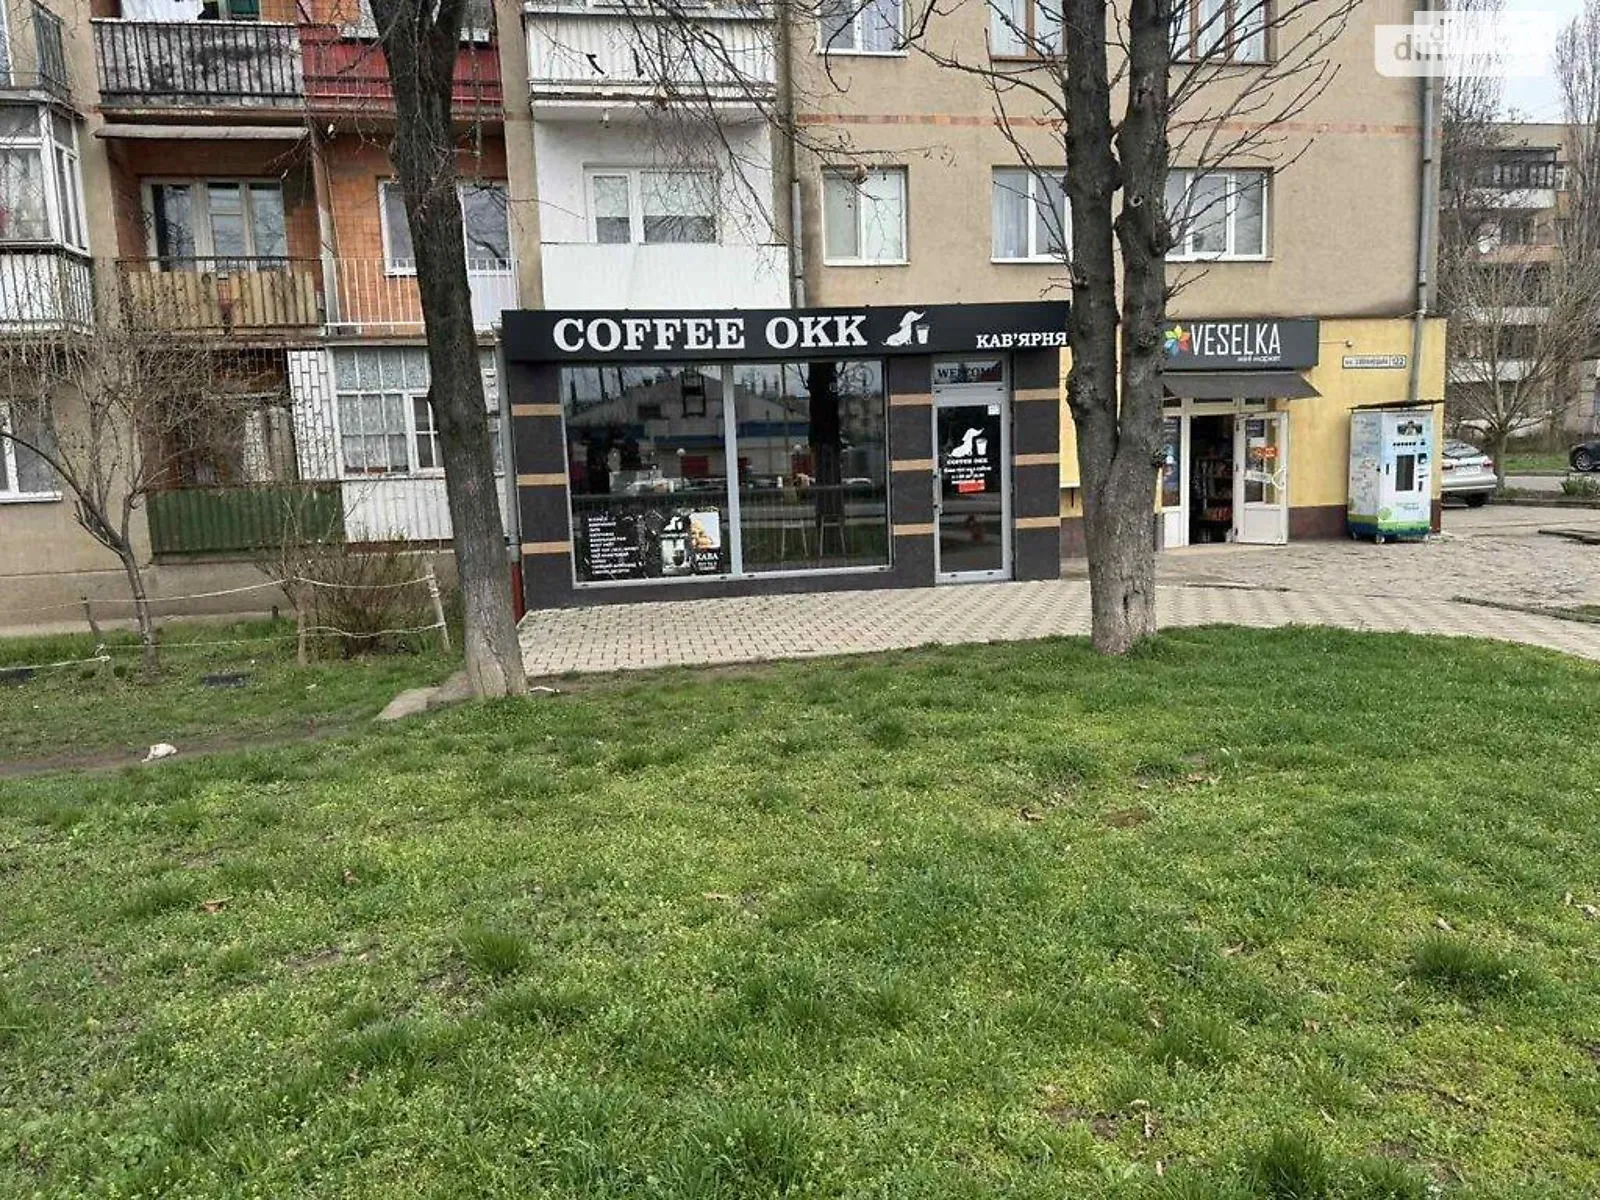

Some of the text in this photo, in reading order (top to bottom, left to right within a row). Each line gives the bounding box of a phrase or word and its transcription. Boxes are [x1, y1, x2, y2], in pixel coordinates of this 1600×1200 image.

[552, 315, 868, 352] COFFEE OKK
[976, 332, 1067, 349] КАВ'ЯРНЯ
[1190, 323, 1281, 356] VESELKA
